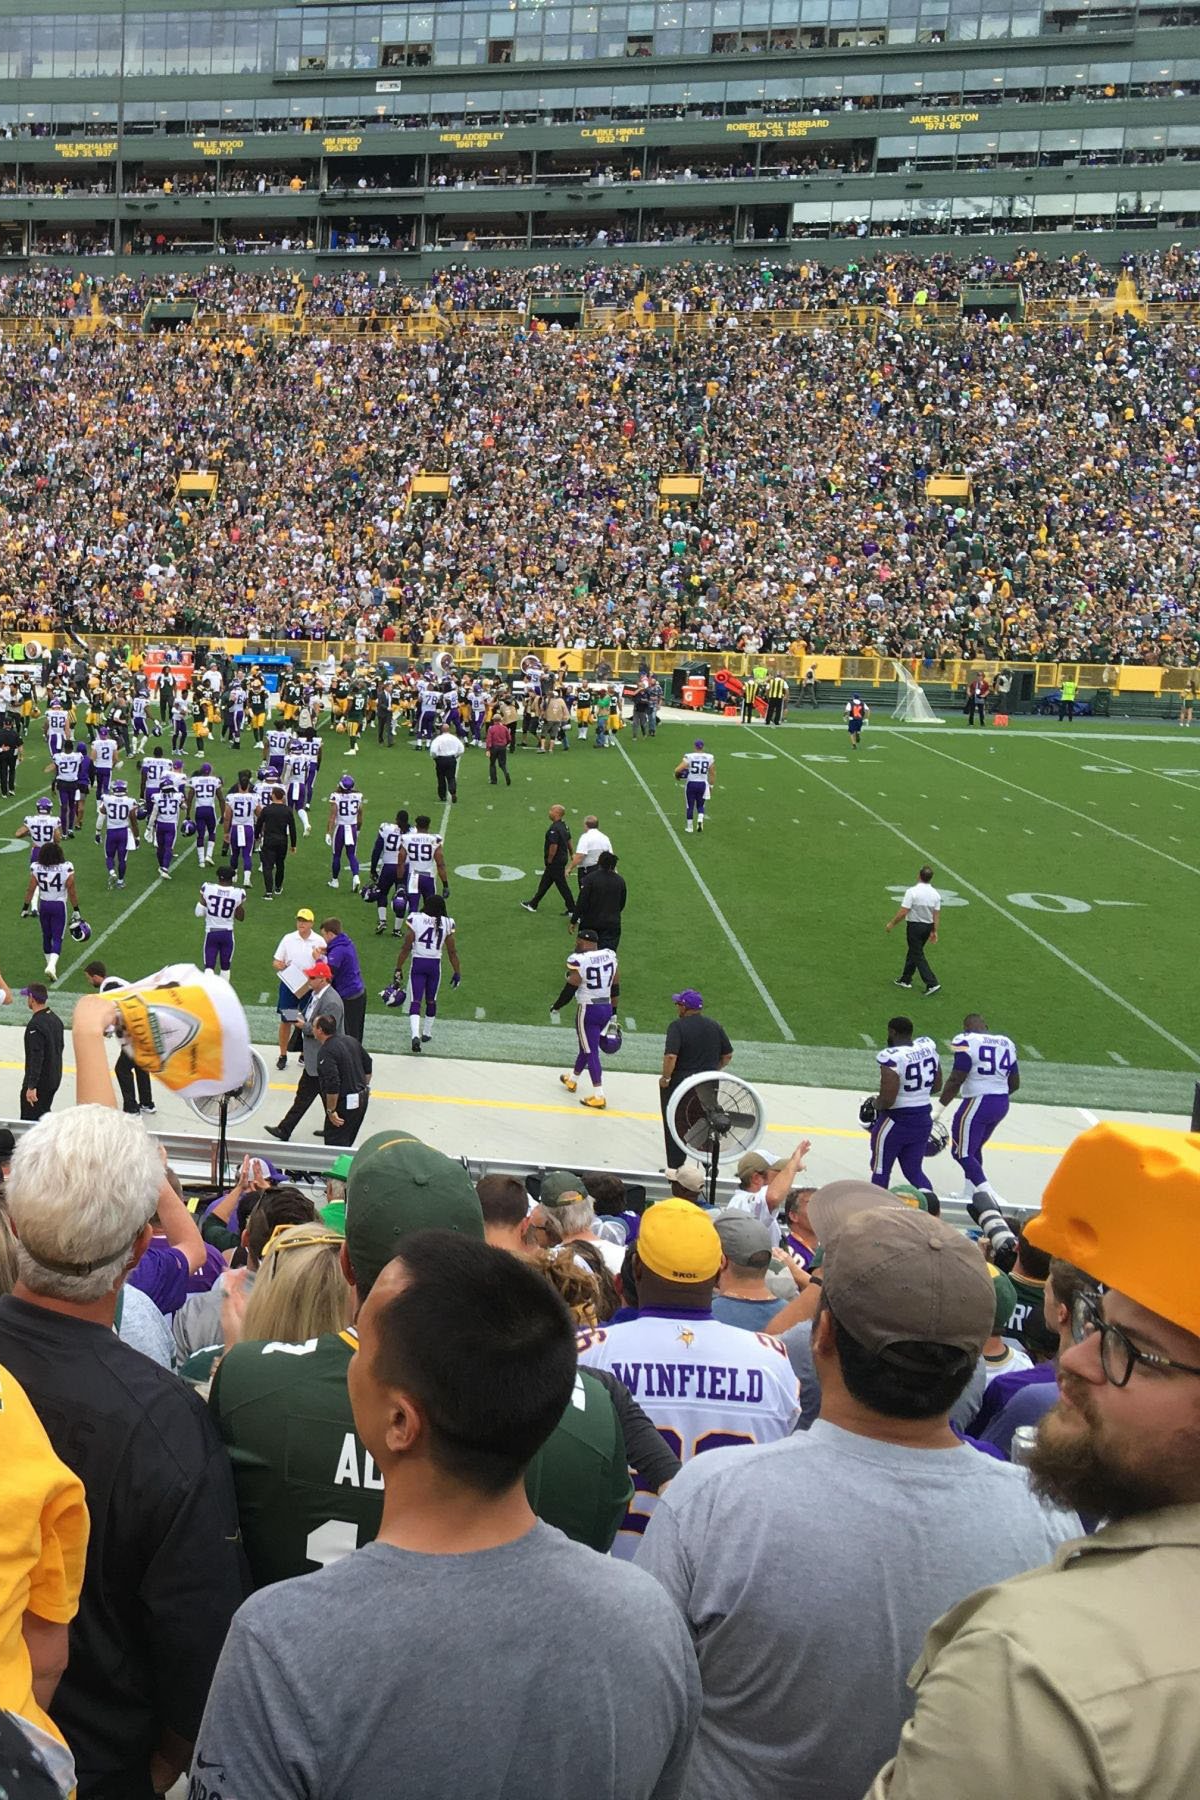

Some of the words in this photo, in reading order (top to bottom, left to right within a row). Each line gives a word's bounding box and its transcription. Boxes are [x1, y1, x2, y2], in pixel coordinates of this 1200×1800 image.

[909, 115, 940, 124] JAMES
[942, 114, 979, 122] LOFTON
[726, 122, 760, 131] ROBERT
[788, 120, 829, 129] HUBBARD
[440, 134, 461, 142] HERB
[462, 132, 504, 141] ADDERLEY
[581, 129, 614, 137] CLARKE
[616, 128, 645, 136] HINKLE
[788, 128, 807, 136] 1935
[55, 143, 74, 151] MIKE
[75, 143, 118, 151] MICHALSKE
[193, 141, 218, 149] WILLIE
[219, 140, 244, 148] WOOD
[337, 137, 362, 145] RINGO
[425, 695, 437, 705] 78
[51, 717, 66, 728] 82
[270, 736, 287, 748] 50
[101, 747, 109, 759] 2
[302, 744, 318, 755] 26
[59, 762, 78, 774] 27
[292, 763, 307, 775] 84
[691, 761, 710, 774] 58
[196, 785, 214, 798] 29
[108, 803, 129, 820] 30
[159, 800, 178, 814] 23
[234, 802, 251, 817] 51
[339, 801, 359, 816] 83
[31, 826, 53, 841] 39
[408, 843, 432, 861] 99
[38, 873, 62, 892] 54
[207, 895, 236, 918] 38
[418, 928, 442, 949] 41
[590, 955, 610, 964] GRIFFEN
[586, 962, 614, 989] 97
[906, 1048, 931, 1062] STEPHEN
[977, 1046, 1012, 1076] 94
[904, 1058, 937, 1092] 93
[672, 1270, 698, 1280] SKOL
[612, 1362, 763, 1403] WINFIELD
